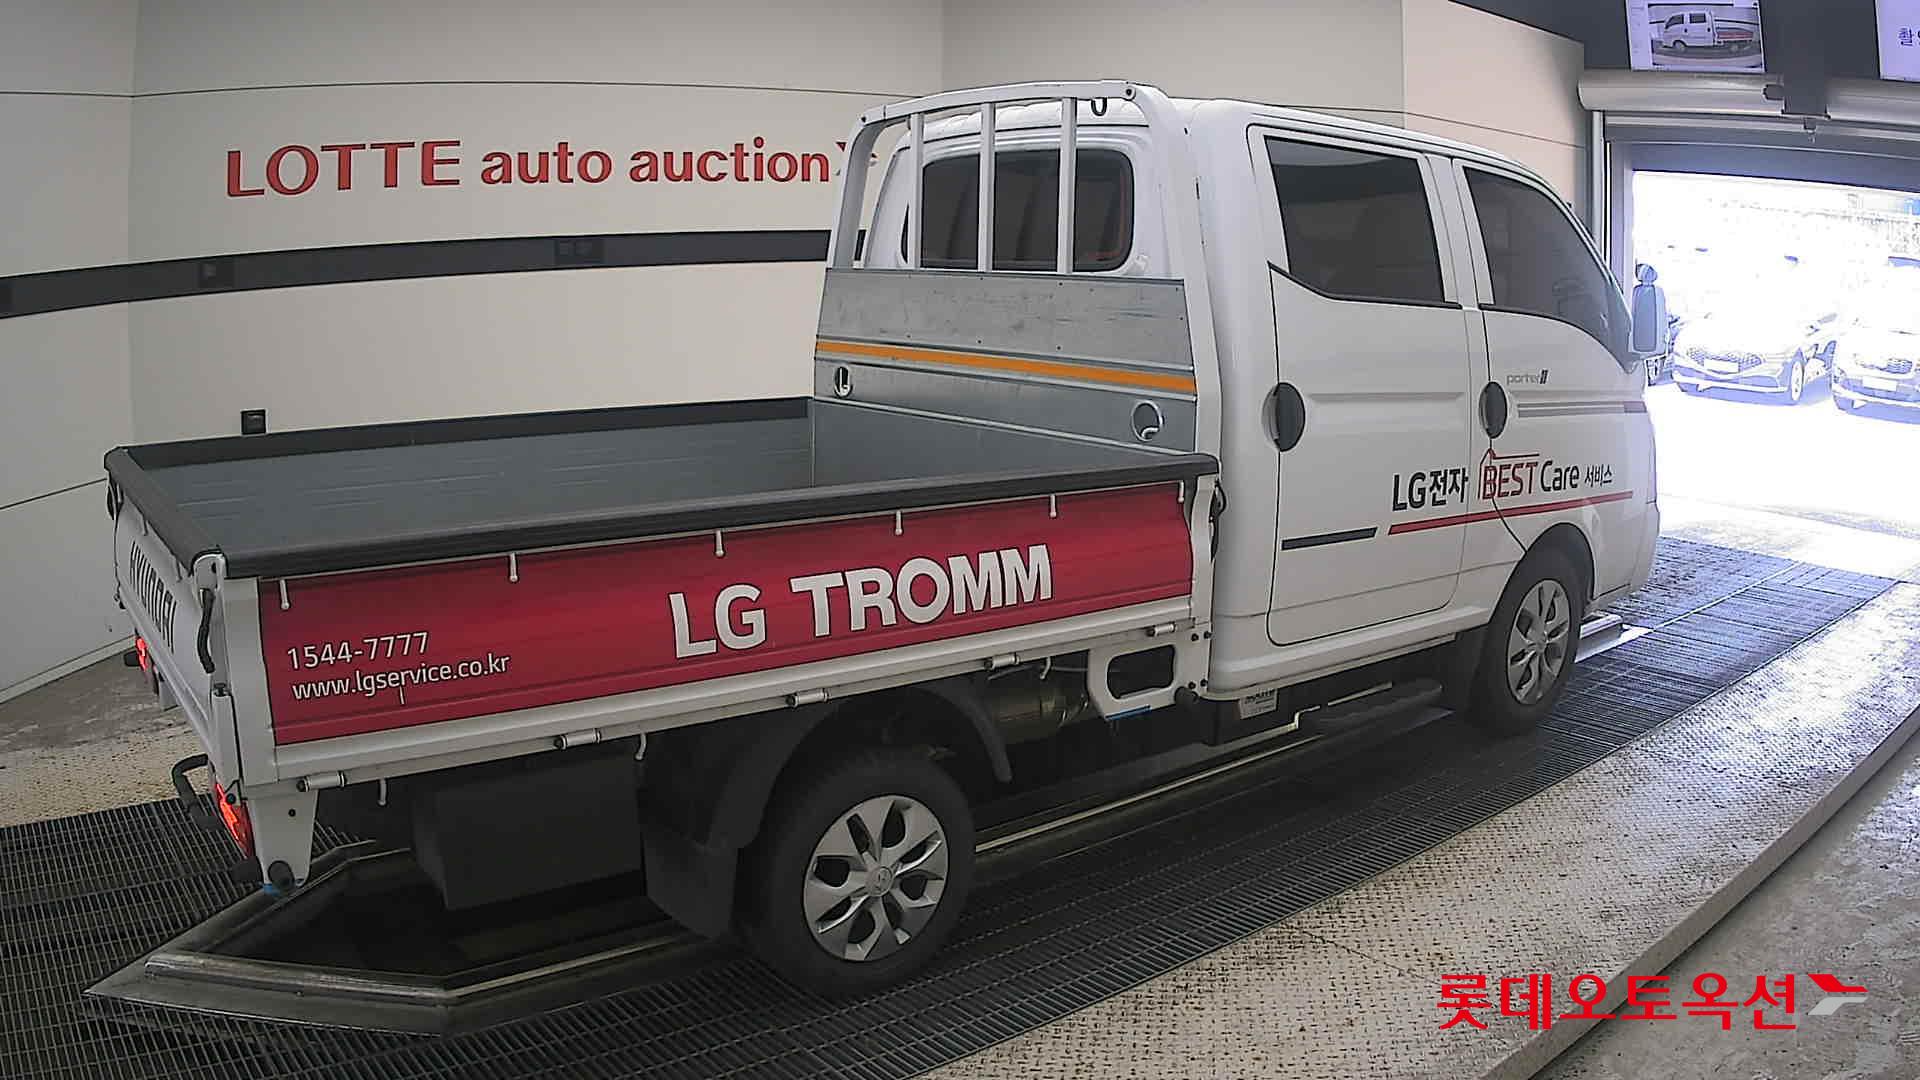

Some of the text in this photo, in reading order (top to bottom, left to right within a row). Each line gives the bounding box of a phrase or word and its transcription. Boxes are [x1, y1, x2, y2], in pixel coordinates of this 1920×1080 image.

[226, 136, 831, 198] LOTTE auto auction
[1392, 459, 1614, 512] LG전자 BEST Care 서비스
[668, 543, 1052, 659] LG TROMM
[287, 631, 429, 670] 1544-7777
[291, 652, 511, 700] www.lgservice.co.kr
